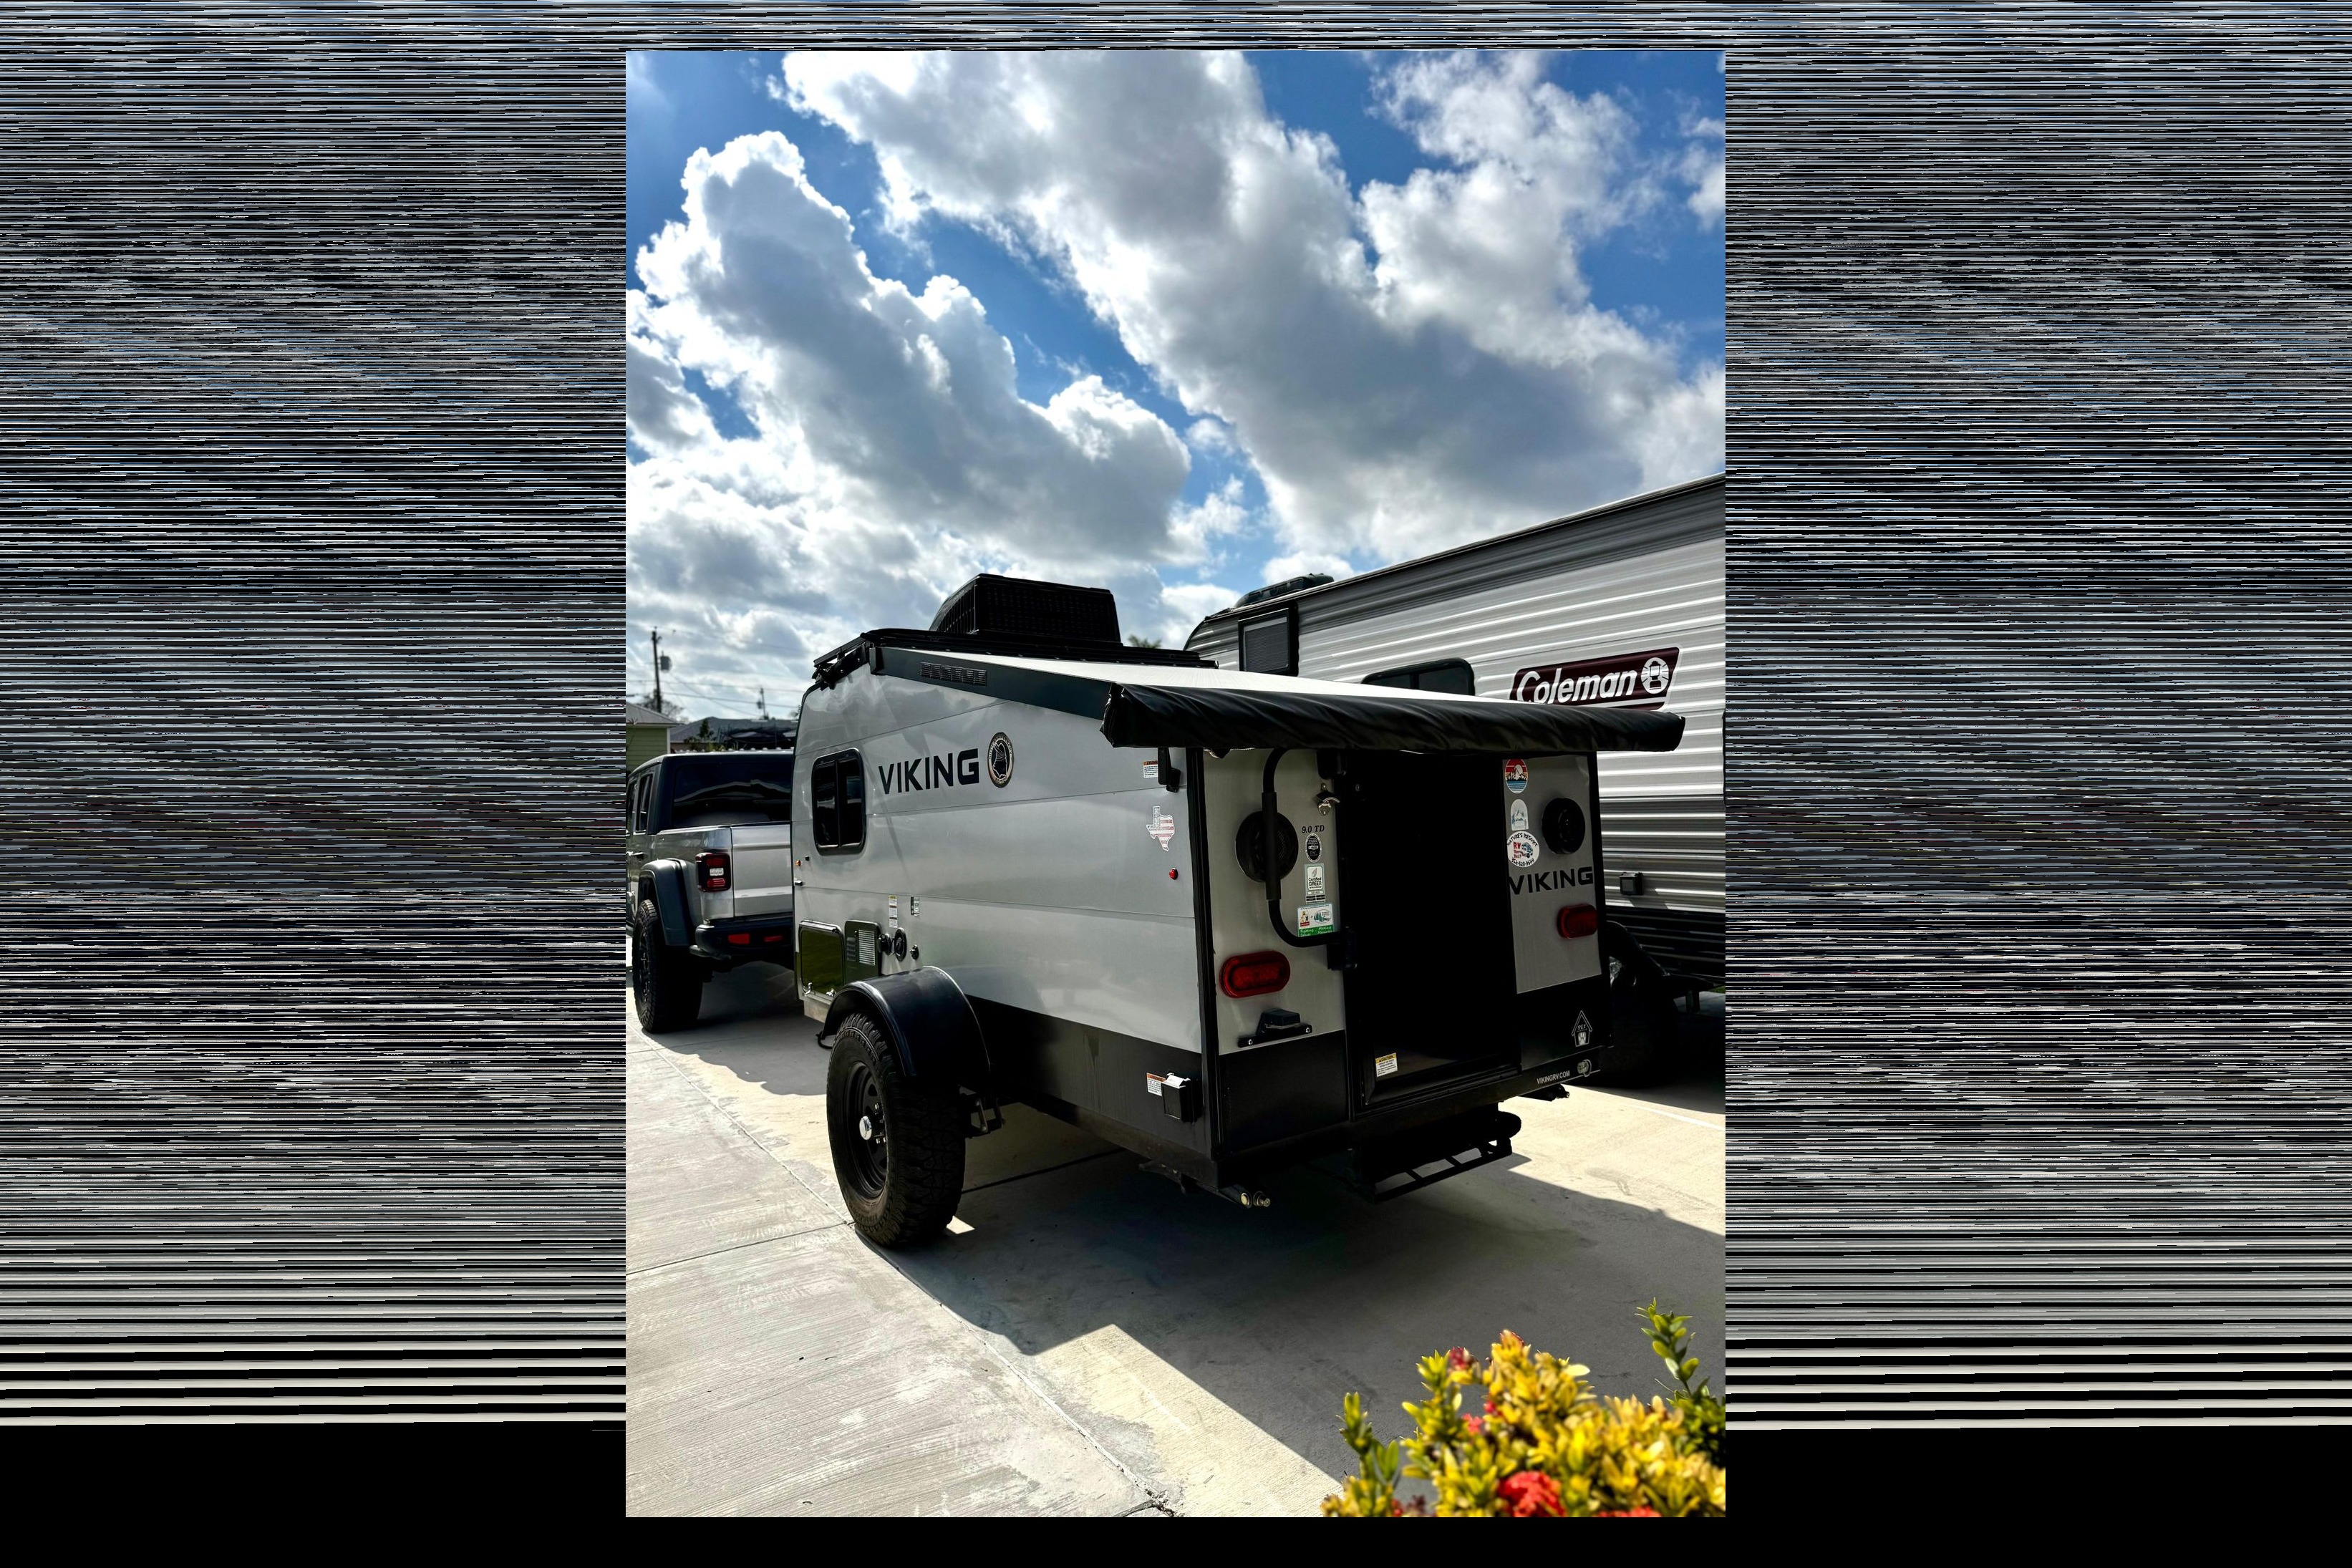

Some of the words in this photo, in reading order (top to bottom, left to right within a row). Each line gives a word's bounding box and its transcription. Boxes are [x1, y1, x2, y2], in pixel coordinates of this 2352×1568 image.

[1516, 668, 1637, 705] Coleman
[879, 748, 979, 795] VIKING
[1509, 866, 1593, 895] VIKING
[1536, 1070, 1570, 1085] VIKINGRV.COM
